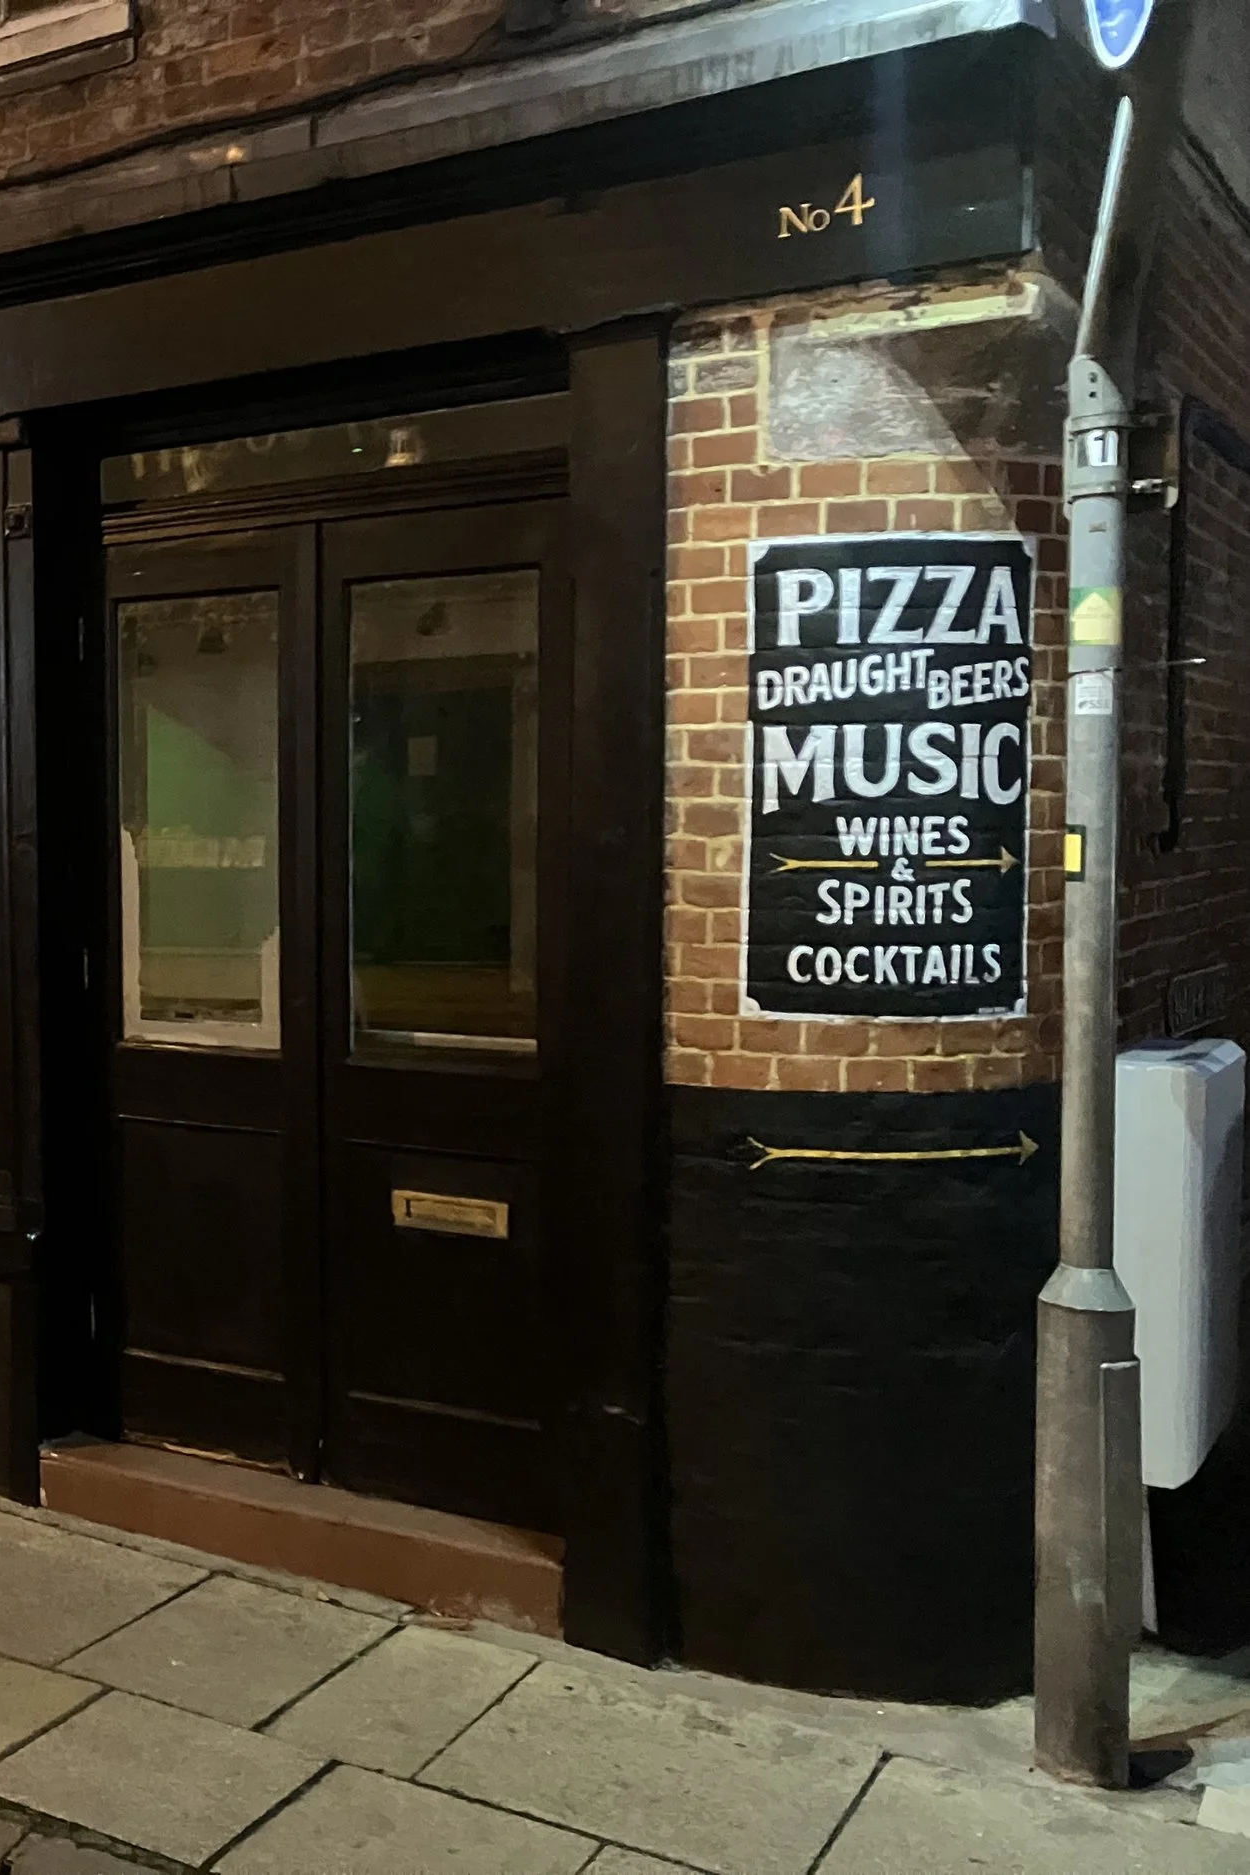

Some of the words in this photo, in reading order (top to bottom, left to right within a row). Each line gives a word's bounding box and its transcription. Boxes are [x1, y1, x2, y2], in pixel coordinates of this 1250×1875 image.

[777, 203, 831, 238] No
[833, 172, 876, 226] 4
[776, 565, 1024, 646] PIZZA
[757, 648, 935, 711] DRAUGHT
[927, 656, 1030, 710] BEERS
[761, 722, 1022, 815] MUSIC
[836, 815, 970, 856] WINES
[891, 857, 916, 882] &
[815, 878, 974, 926] SPIRITS
[786, 943, 1003, 986] COCKTAILS
